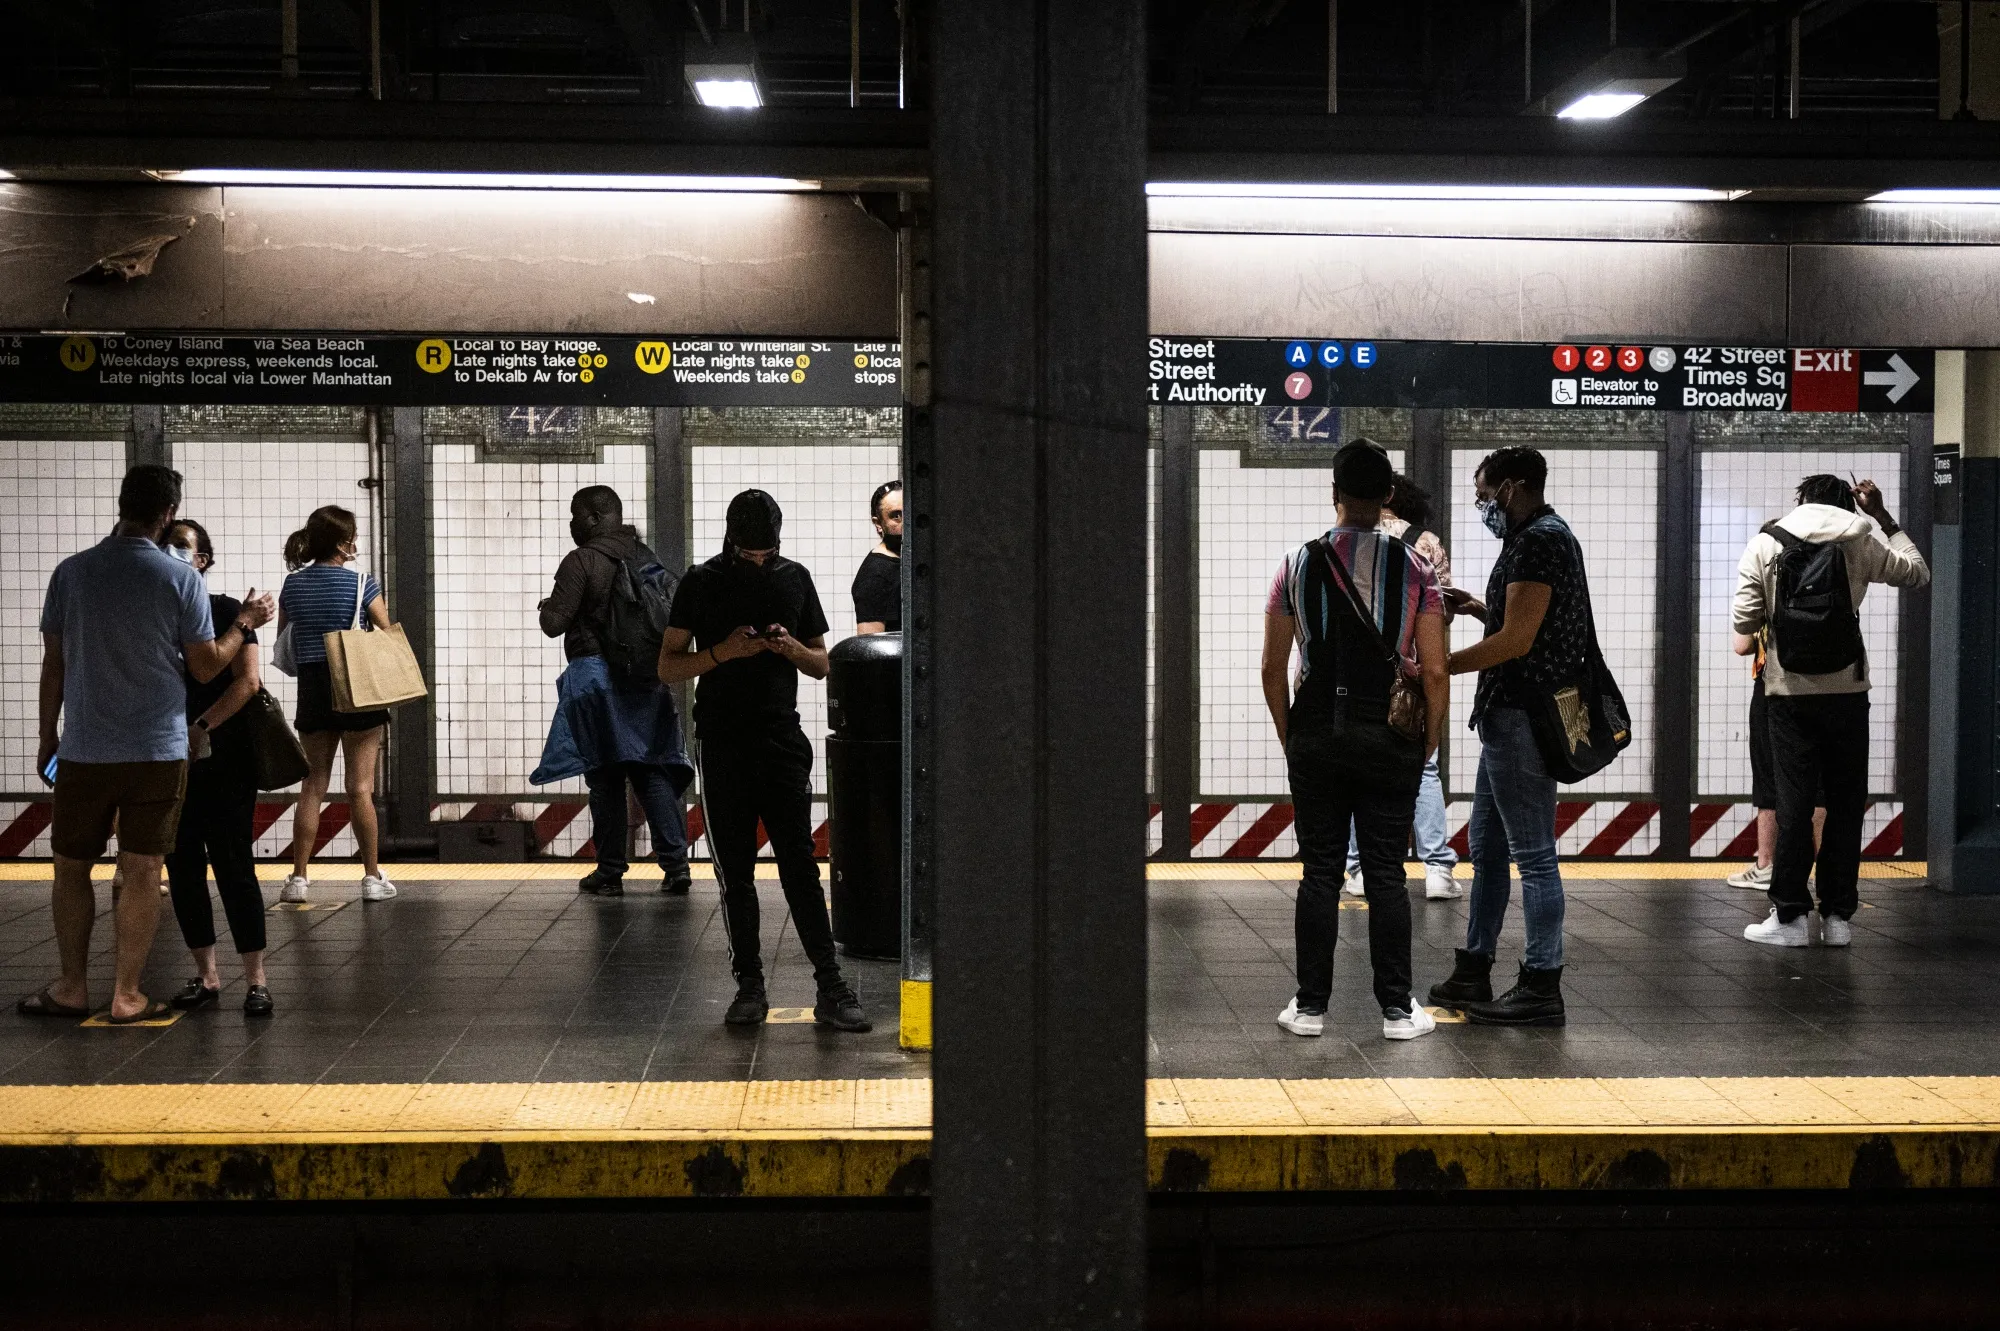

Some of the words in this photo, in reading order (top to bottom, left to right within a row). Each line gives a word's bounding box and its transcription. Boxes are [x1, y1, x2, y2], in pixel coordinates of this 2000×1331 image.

[102, 337, 117, 349] To
[124, 337, 173, 351] Coney
[179, 337, 223, 349] Island
[254, 338, 275, 350] via
[281, 338, 310, 350] Sea
[317, 338, 365, 350] Beach
[454, 340, 494, 351] Local
[500, 340, 515, 351] to
[521, 340, 549, 353] Bay
[673, 341, 712, 351] Local
[719, 342, 734, 352] to
[811, 343, 831, 352] St.
[1149, 338, 1215, 358] Street
[0, 352, 20, 366] via
[69, 344, 86, 362] N
[426, 346, 442, 365] R
[641, 347, 665, 366] W
[1291, 347, 1306, 362] A
[1323, 346, 1339, 363] C
[1357, 347, 1370, 363] E
[1592, 350, 1605, 366] 2
[1624, 350, 1637, 366] 3
[1656, 350, 1669, 367] S
[1684, 348, 1712, 364] 42
[1721, 348, 1786, 364] Street
[1794, 349, 1852, 372] Exit
[100, 353, 179, 369] Weekdays
[185, 357, 250, 370] express,
[256, 355, 333, 368] weekends
[339, 355, 379, 368] local.
[454, 353, 487, 367] Late
[493, 353, 537, 370] nights
[542, 353, 576, 367] take
[673, 353, 706, 367] Late
[711, 353, 755, 370] nights
[761, 354, 794, 367] take
[455, 370, 470, 383] to
[475, 369, 527, 383] Dekalb
[533, 369, 551, 383] Av
[557, 369, 578, 383] for
[673, 369, 751, 383] Weekends
[757, 370, 789, 383] take
[1149, 360, 1215, 380] Street
[1684, 366, 1747, 385] Times
[1757, 366, 1786, 389] Sq
[100, 371, 133, 384] Late
[139, 371, 185, 387] nights
[191, 371, 226, 385] local
[233, 372, 254, 385] via
[260, 372, 306, 385] Lower
[313, 372, 392, 386] Manhattan
[854, 371, 896, 386] stops
[1291, 378, 1305, 394] 7
[1581, 378, 1639, 391] Elevator
[1644, 380, 1659, 391] to
[1167, 382, 1266, 406] Authority
[1581, 392, 1656, 406] mezzanine
[1683, 388, 1787, 411] Broadway
[1934, 457, 1951, 470] Times
[1934, 471, 1952, 487] Square
